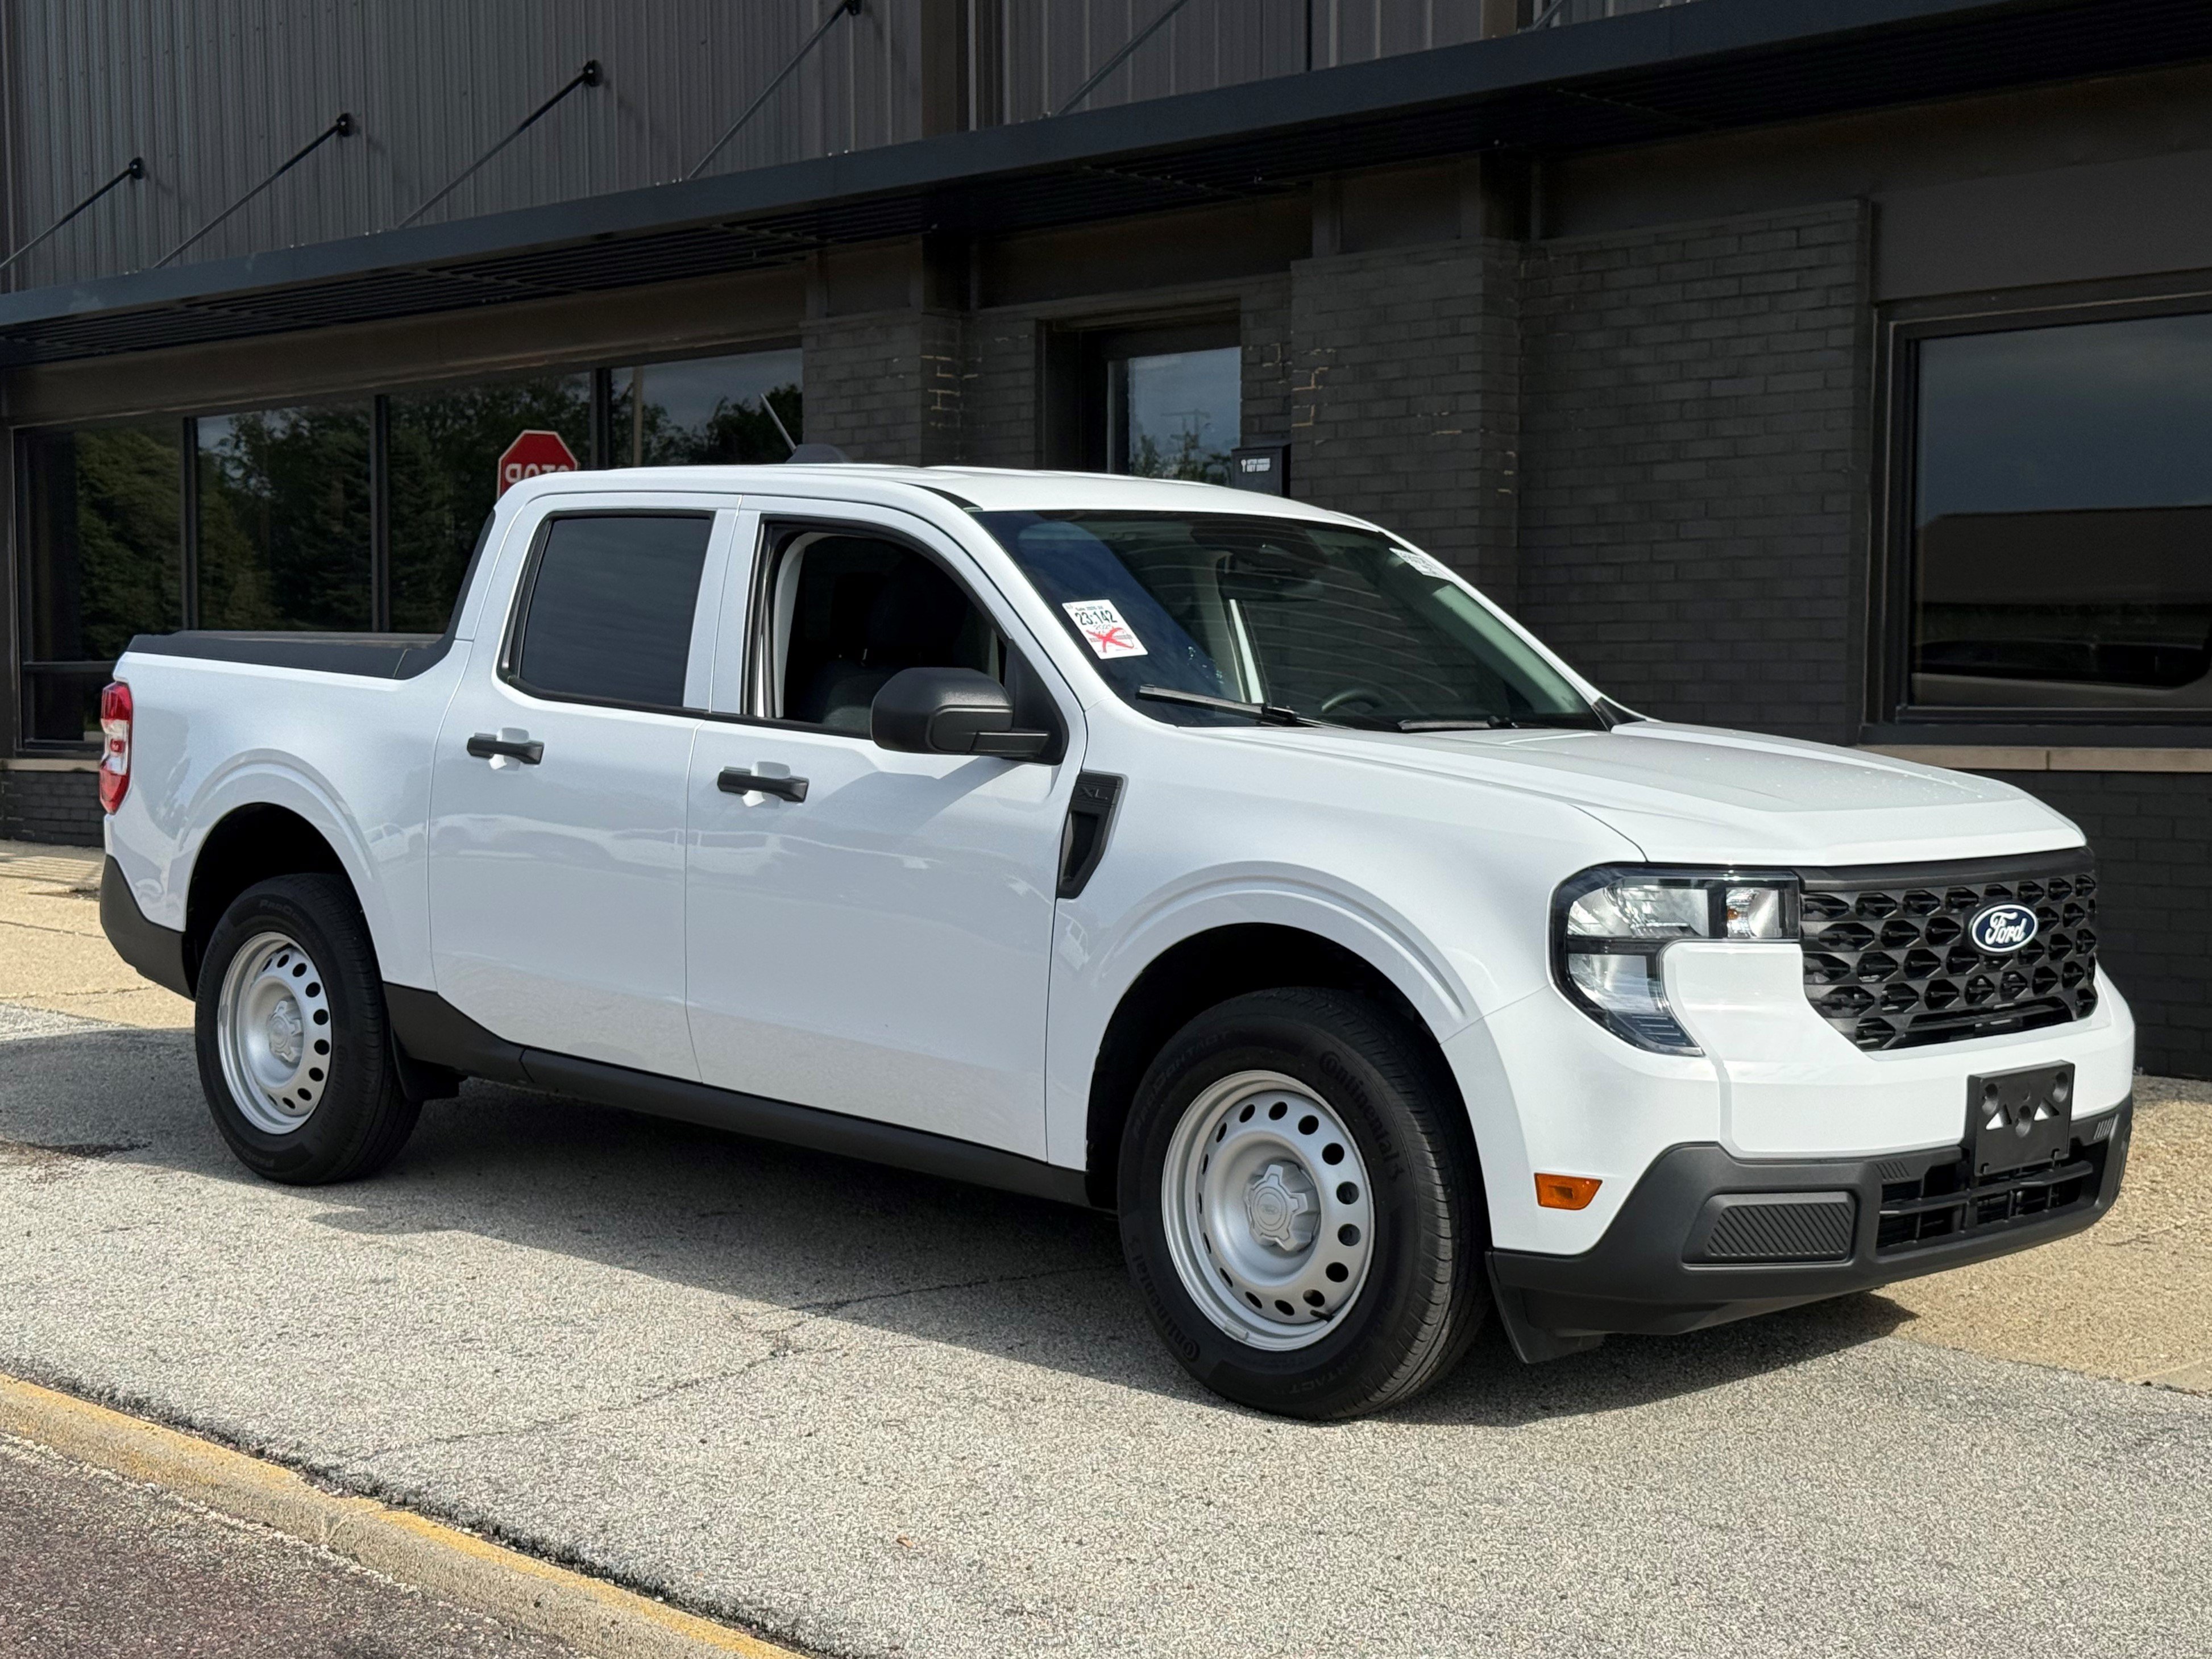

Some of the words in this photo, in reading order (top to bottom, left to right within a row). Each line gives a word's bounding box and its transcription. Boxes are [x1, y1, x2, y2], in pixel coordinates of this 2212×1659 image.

[1075, 610, 1118, 625] 23:142
[1985, 911, 2028, 945] Ford
[1318, 1050, 1400, 1164] Continental
[1131, 1252, 1201, 1363] Continental
